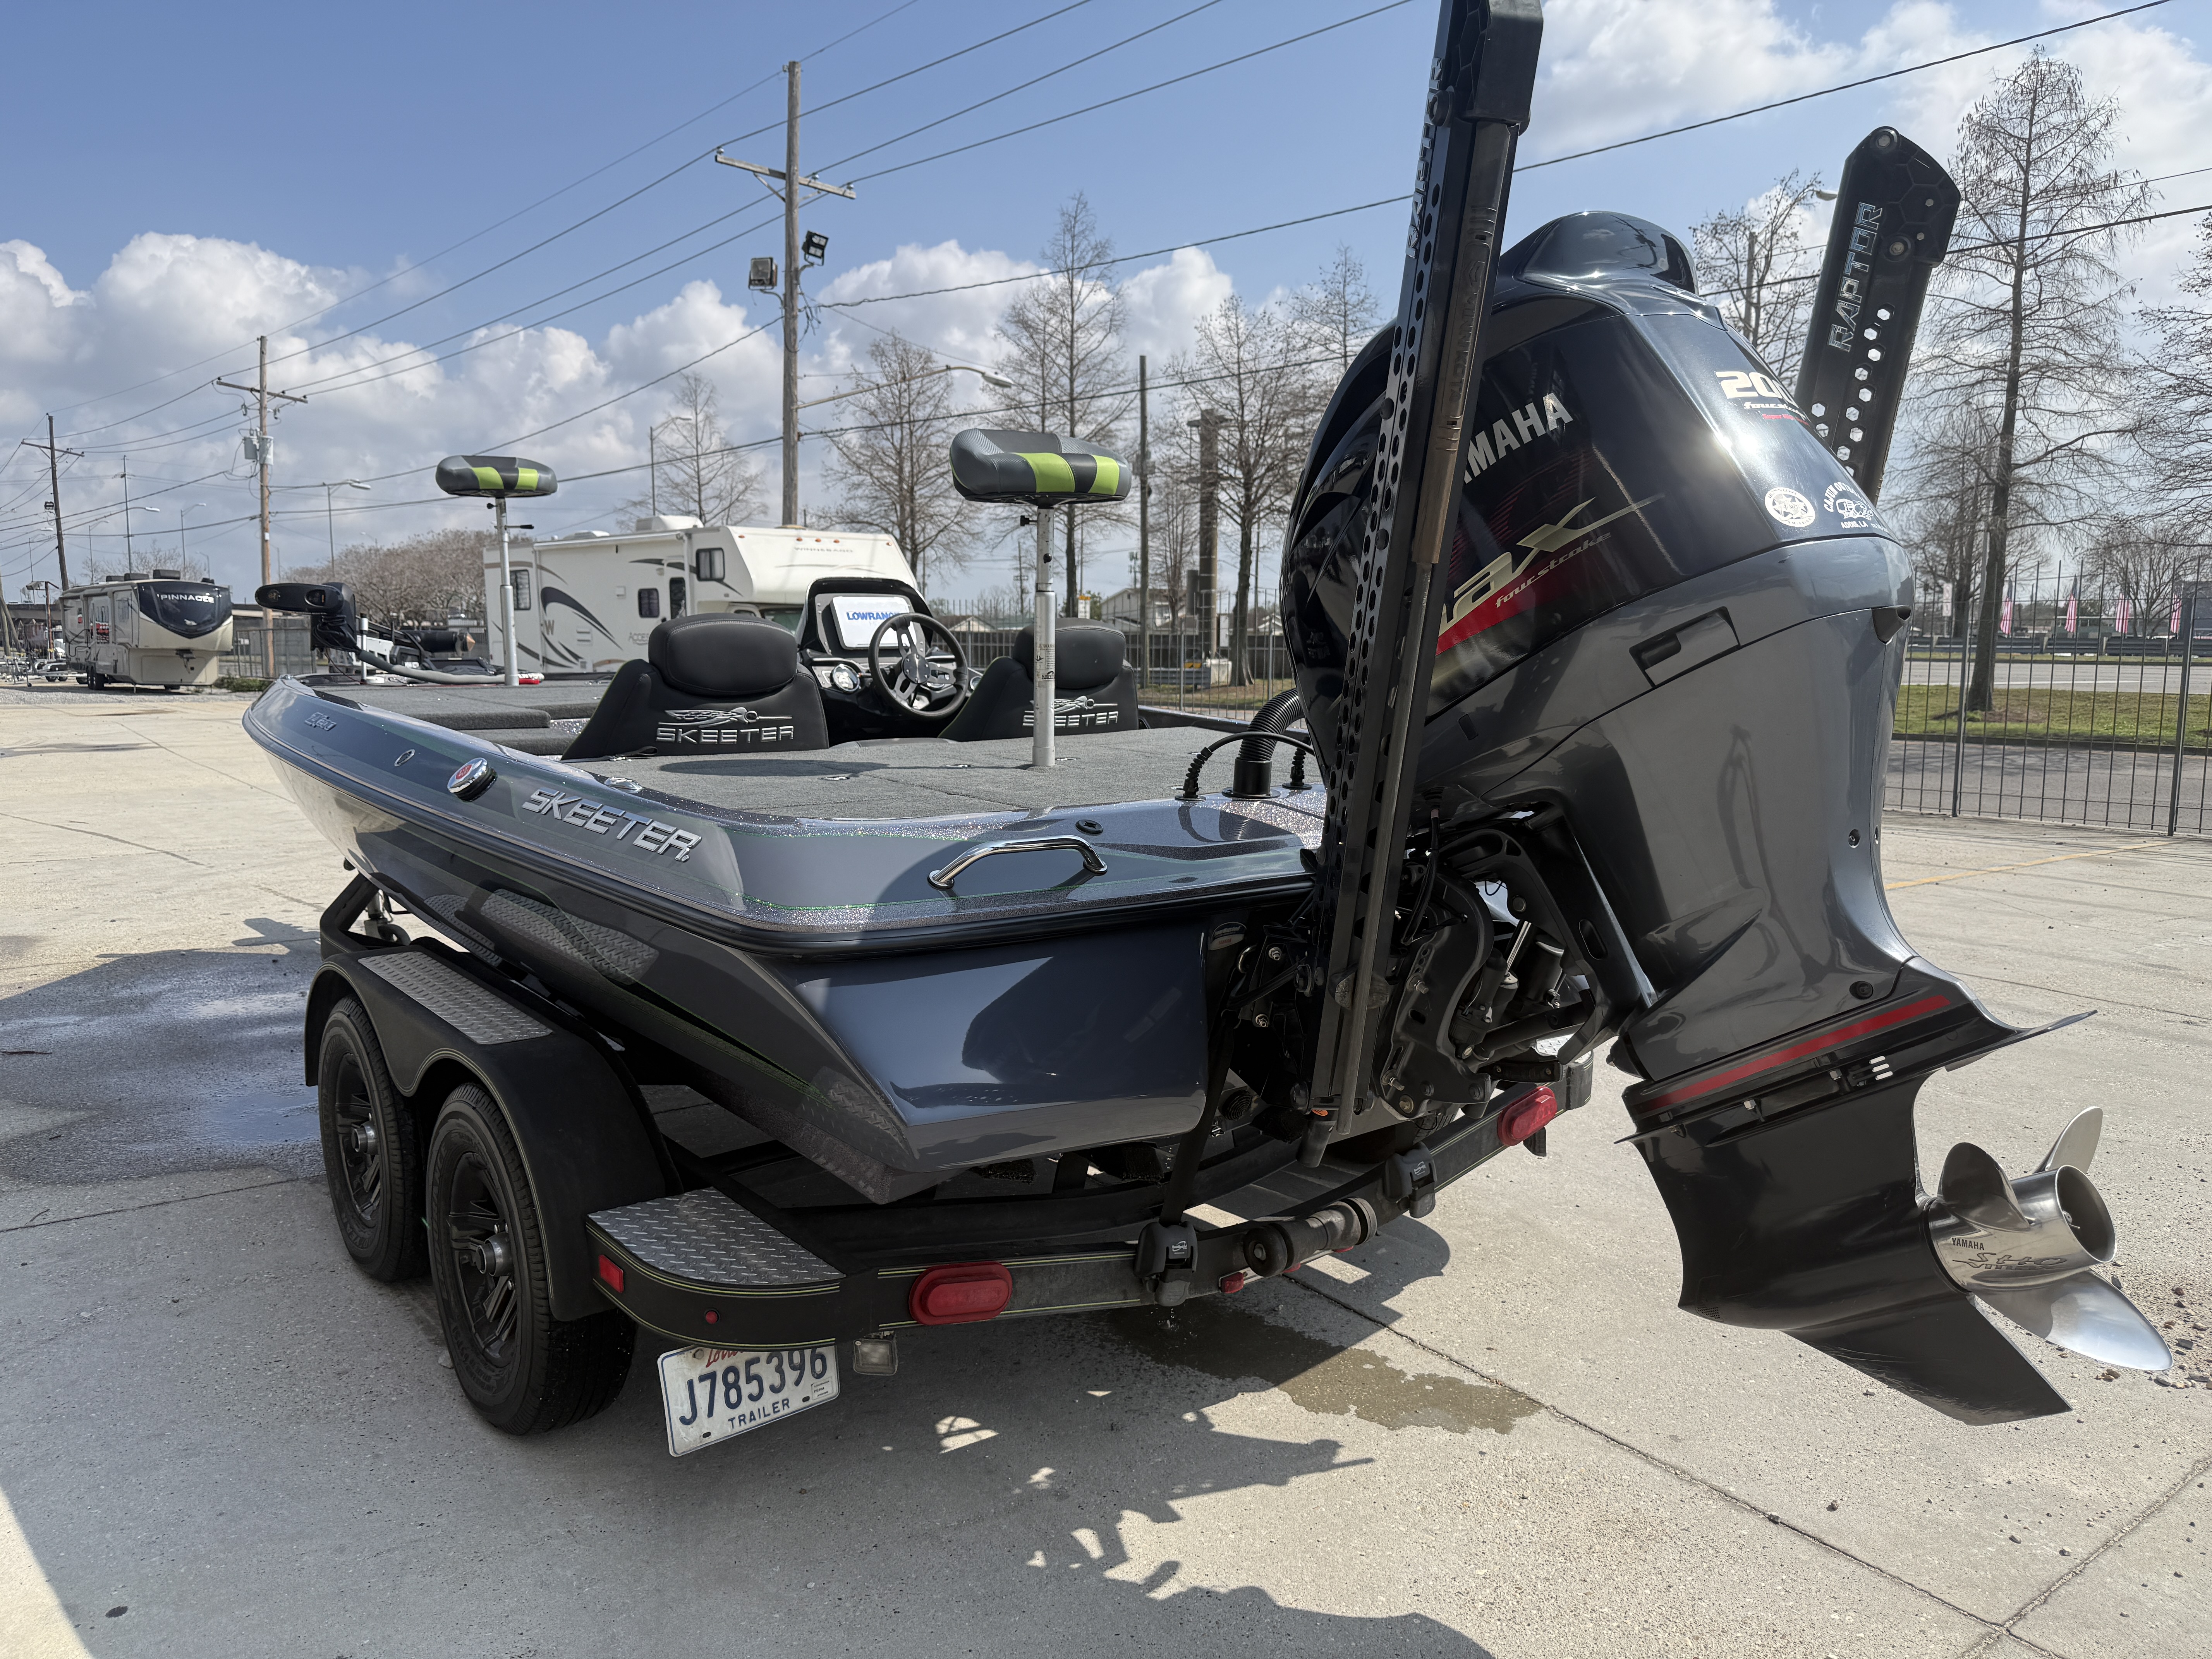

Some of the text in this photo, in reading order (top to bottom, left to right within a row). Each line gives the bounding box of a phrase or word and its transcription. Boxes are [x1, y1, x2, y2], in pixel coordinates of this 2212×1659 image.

[1827, 201, 1884, 353] RAPTOR
[1464, 392, 1574, 484] MAHA
[846, 612, 899, 620] LOWRANC
[1022, 711, 1118, 727] SEETER
[656, 726, 794, 744] SKEETER
[522, 787, 702, 862] SKEETER
[1951, 1237, 1985, 1250] YAMAHA
[1968, 1252, 2068, 1266] SHO
[679, 1348, 828, 1425] J785396
[728, 1398, 790, 1429] TRAILER
